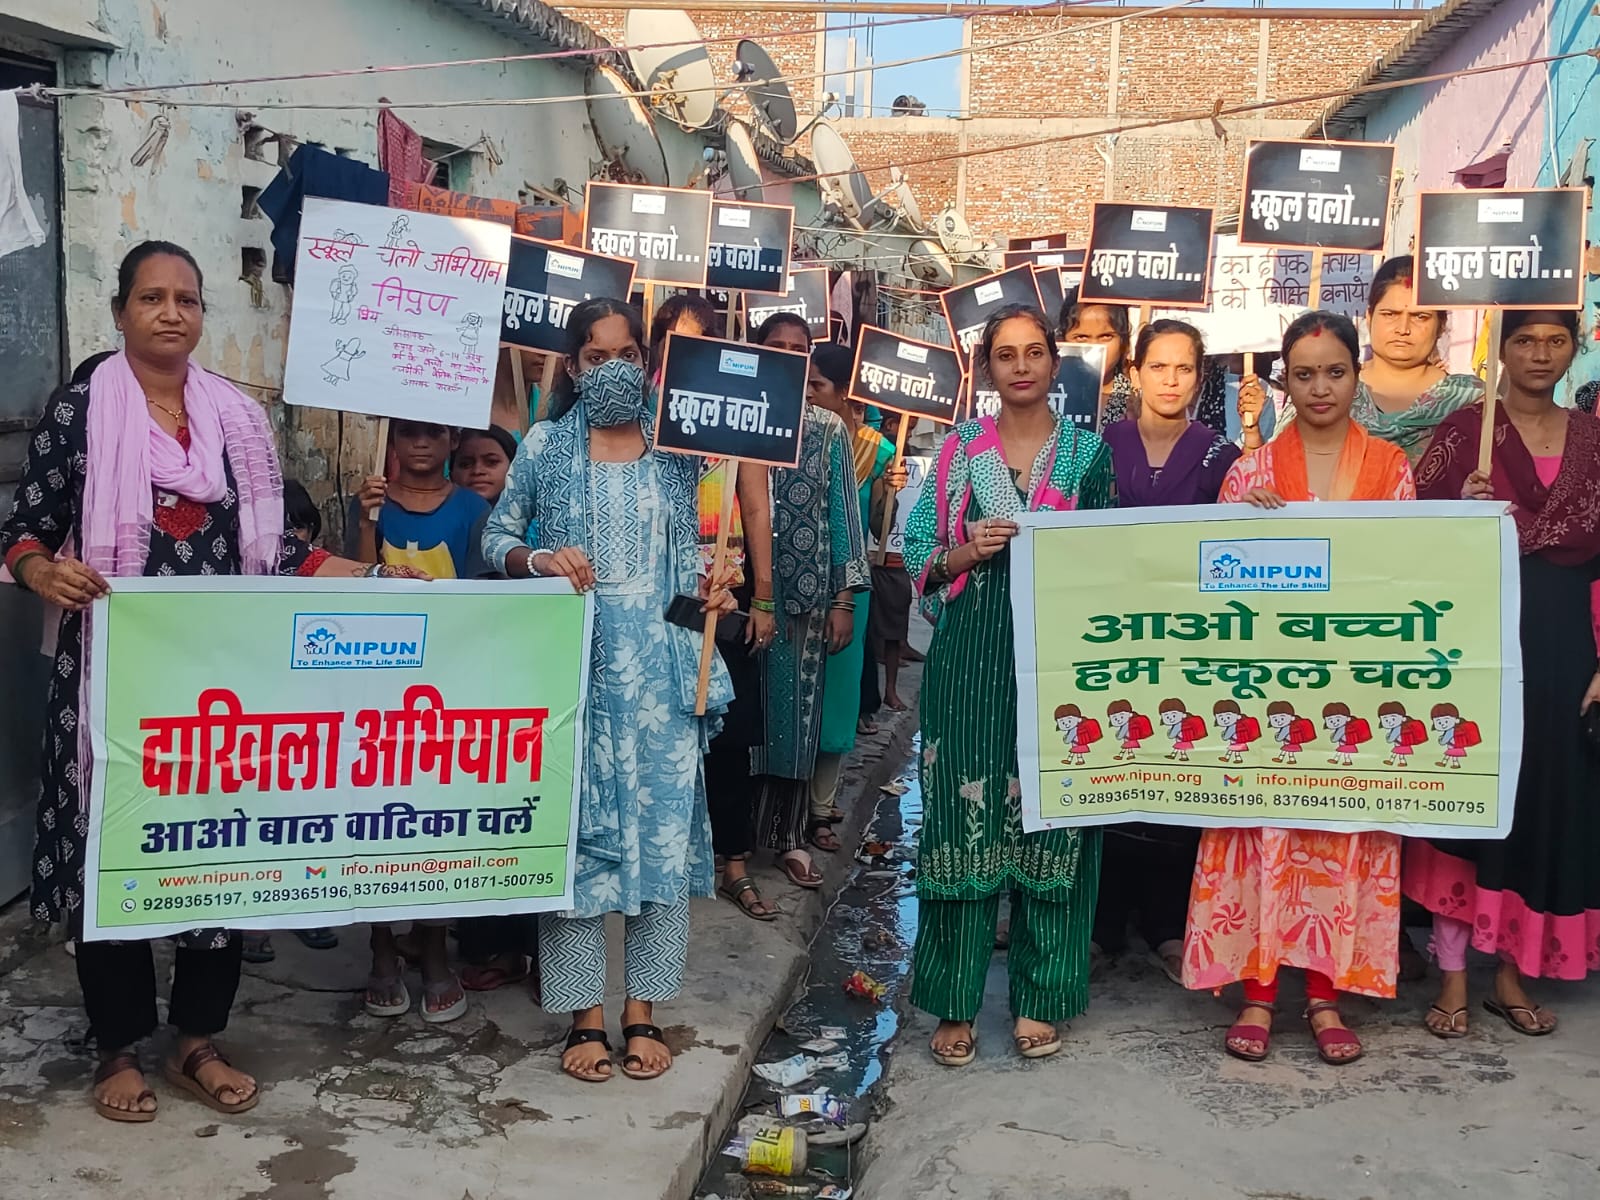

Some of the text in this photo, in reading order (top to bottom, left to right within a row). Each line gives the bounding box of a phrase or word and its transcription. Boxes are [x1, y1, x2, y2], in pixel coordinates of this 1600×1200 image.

[1250, 184, 1380, 232] स्कूल चलो...
[303, 237, 508, 285] स्कूल चलो अभियान
[639, 225, 699, 263] चलो...
[725, 238, 783, 273] चलो...
[1425, 234, 1573, 291] स्कूल चलो...
[1091, 242, 1201, 287] स्कूल चलो...
[1220, 255, 1253, 275] का
[372, 277, 458, 316] निपुण
[503, 286, 548, 330] कूल
[1222, 277, 1250, 310] को
[732, 361, 756, 372] NIPUN
[860, 361, 952, 405] स्कूल चलो...
[669, 389, 793, 438] स्कूल चलो...
[1240, 566, 1322, 578] NIPUN
[1081, 599, 1454, 643] आओ बच्चों
[334, 642, 417, 655] NIPUN
[1072, 647, 1463, 699] हम स्कूल चलें
[140, 685, 549, 796] दाखिला अभियान
[1090, 769, 1445, 791] www.nipun.org info.nipun@gmail.com
[1079, 789, 1485, 814] 9289365197, 9289365196, 8376941500, 01871-500795
[141, 796, 541, 854] आओ बाल वाटिका चलें
[159, 855, 518, 888] www.nipun.org info.nipun@gmail.com
[143, 873, 553, 911] 9289365197, 9289365196, 8376941500, 01871-500795
